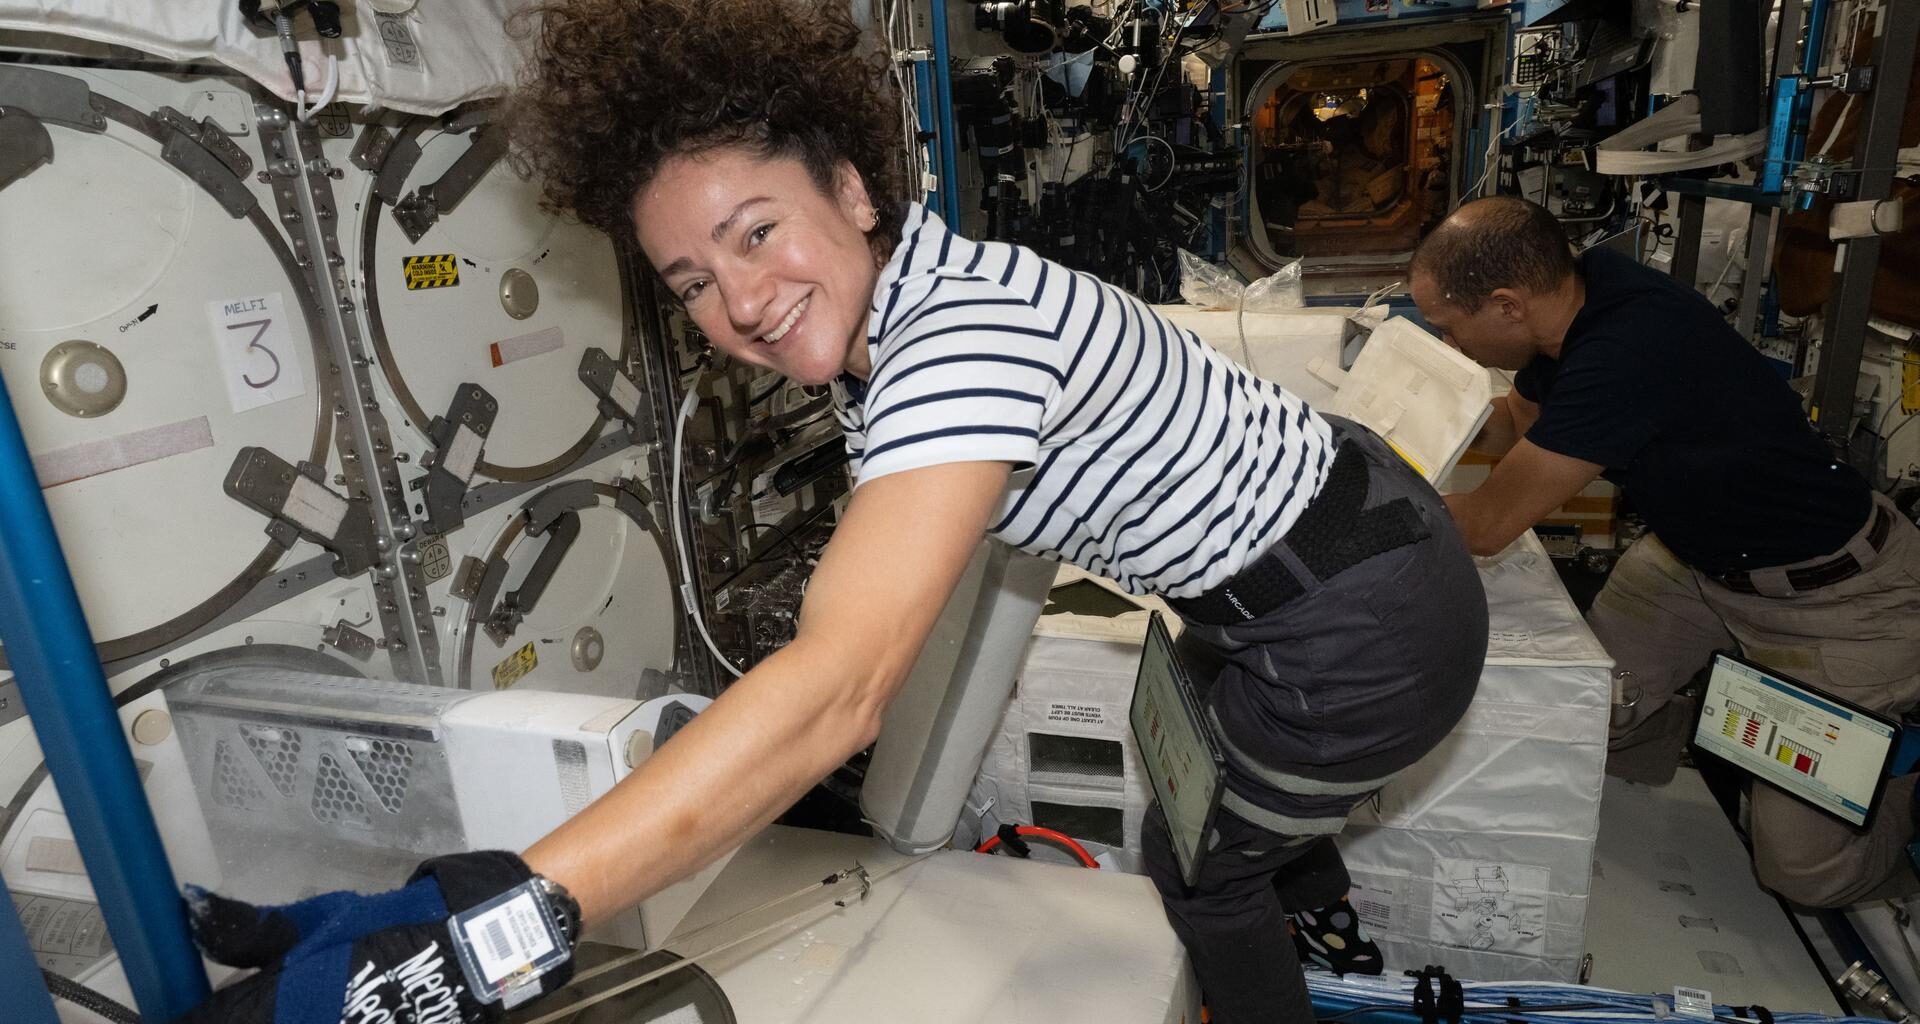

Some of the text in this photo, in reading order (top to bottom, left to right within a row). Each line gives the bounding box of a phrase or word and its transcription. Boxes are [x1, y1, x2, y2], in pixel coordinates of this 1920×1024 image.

[224, 298, 268, 316] MELFI
[226, 318, 281, 389] 3
[1225, 593, 1255, 620] ARCADE
